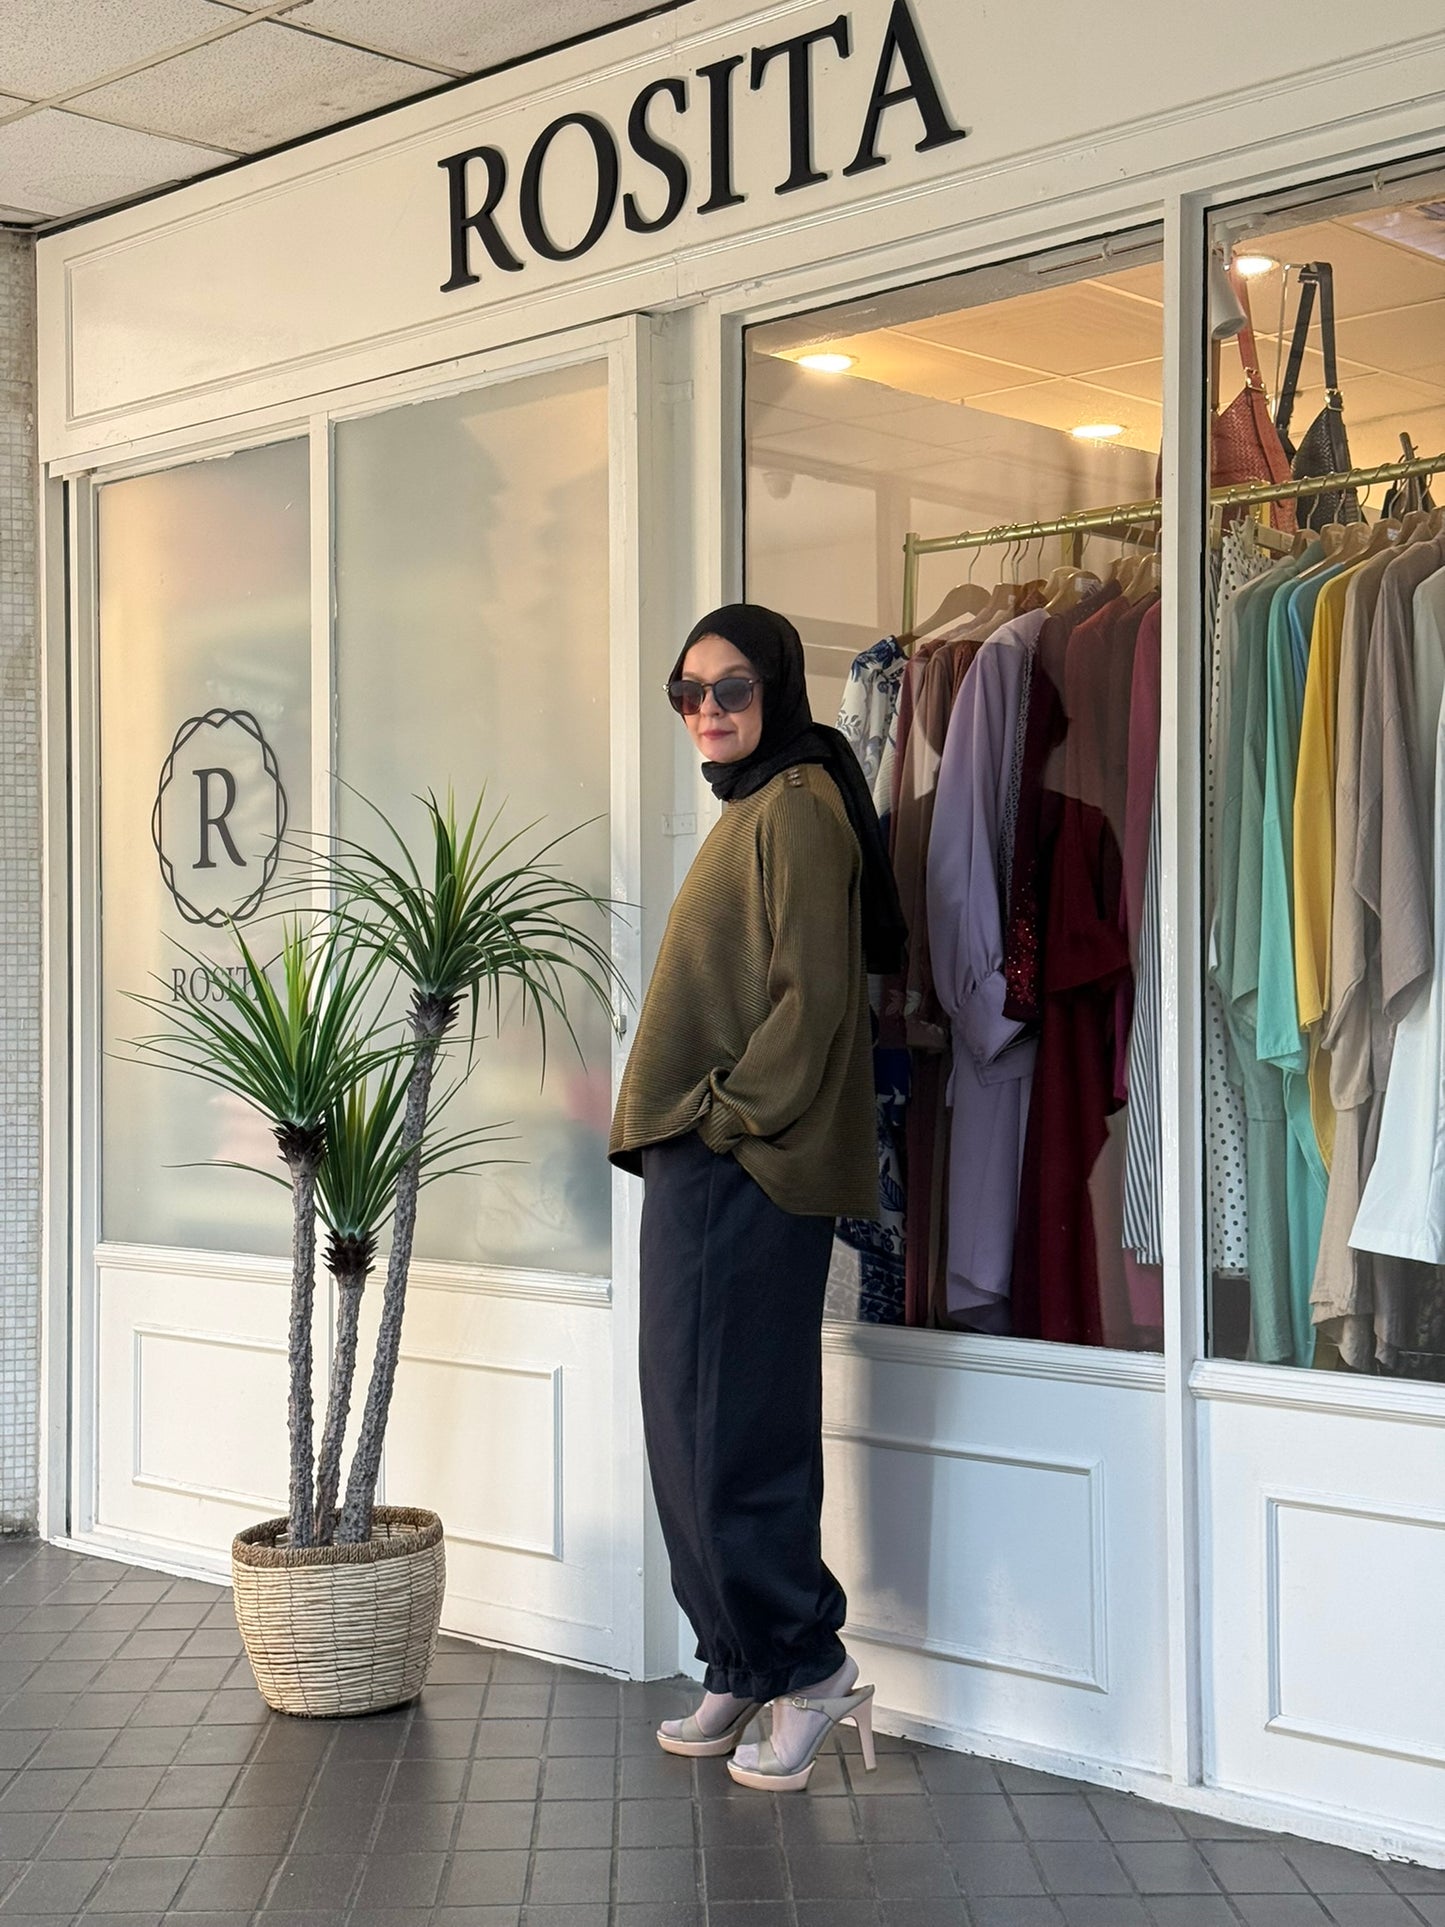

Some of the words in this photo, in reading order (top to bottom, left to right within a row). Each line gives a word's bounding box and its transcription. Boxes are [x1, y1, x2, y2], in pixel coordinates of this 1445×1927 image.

[437, 0, 966, 292] ROSITA
[192, 767, 247, 869] R
[171, 966, 268, 1002] ROSIT
